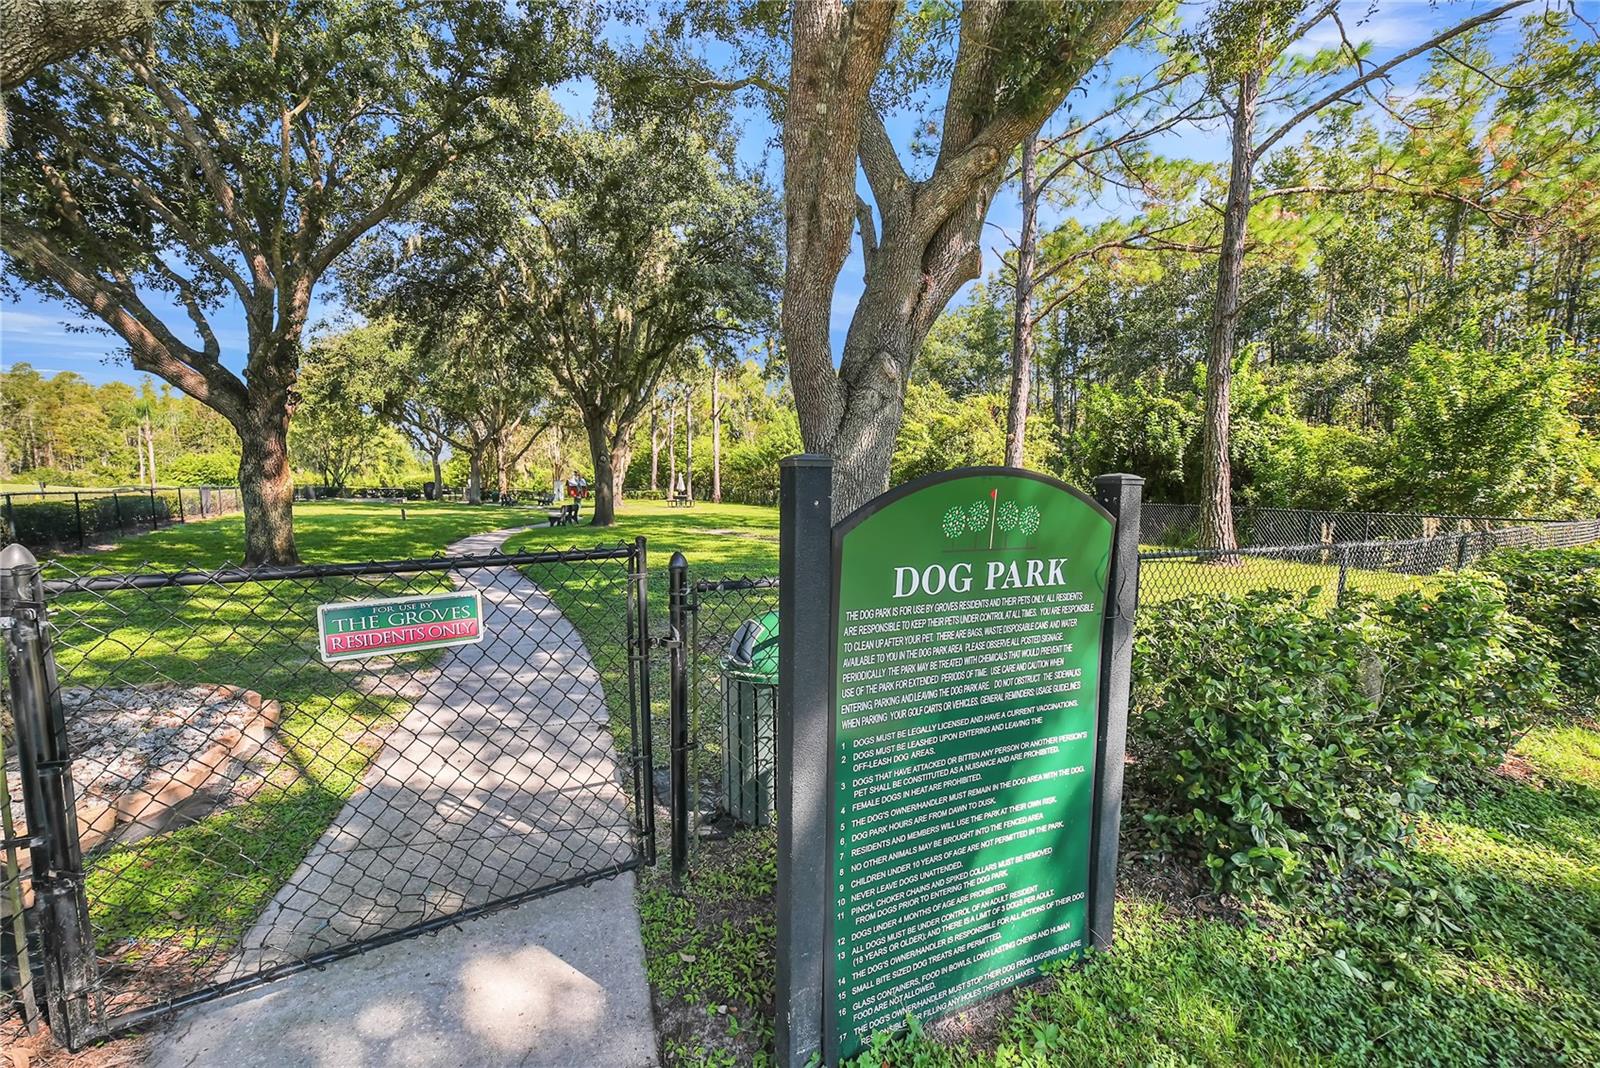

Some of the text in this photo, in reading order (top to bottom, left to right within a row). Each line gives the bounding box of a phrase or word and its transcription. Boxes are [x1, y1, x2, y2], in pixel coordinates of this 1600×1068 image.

[892, 558, 1068, 598] DOG PARK
[331, 605, 471, 632] THE GROVES
[372, 605, 395, 614] FOR
[398, 603, 417, 611] USE
[846, 610, 858, 621] THE
[860, 609, 874, 620] DOG
[875, 607, 891, 618] PARK
[892, 607, 898, 616] IS
[899, 606, 911, 615] FOR
[913, 604, 925, 614] USE
[926, 604, 934, 613] BY
[934, 601, 958, 612] GROVES
[959, 599, 989, 610] RESIDENTS
[989, 598, 1001, 607] AND
[1002, 597, 1017, 606] THEIR
[1017, 595, 1030, 605] PETS
[1046, 594, 1055, 602] ALL
[1056, 592, 1083, 601] RESIDENTS
[331, 622, 475, 650] RESIDENTS ONLY
[843, 654, 875, 668] AVAILABLE
[876, 653, 885, 663] TO
[886, 652, 898, 662] YOU
[899, 651, 905, 660] IN
[906, 649, 918, 659] THE
[918, 647, 932, 657] DOG
[933, 645, 948, 655] PARK
[965, 641, 985, 652] PLEASE
[986, 638, 1010, 649] OBSERVE
[1010, 638, 1019, 646] ALL
[1020, 635, 1041, 645] POSTED
[888, 666, 900, 676] THE
[901, 664, 916, 674] PARK
[917, 662, 929, 672] MAY
[930, 661, 937, 670] BE
[939, 657, 963, 669] TREATED
[964, 655, 978, 665] WITH
[978, 651, 1008, 663] CHEMICALS
[1009, 650, 1021, 659] THAT
[1022, 648, 1040, 657] WOULD
[1040, 645, 1062, 655] PREVENT
[1063, 643, 1072, 652] THE
[853, 736, 874, 747] DOGS
[876, 732, 896, 742] MUST
[897, 729, 906, 738] BE
[907, 724, 937, 736] LEGALLY
[937, 718, 969, 730] LICENSED
[970, 715, 983, 724] AND
[984, 712, 1000, 721] HAVE
[1007, 706, 1035, 717] CURRENT
[853, 749, 874, 761] DOGS
[876, 745, 895, 756] MUST
[896, 742, 906, 751] BE
[907, 736, 938, 749] LEASHED
[939, 732, 958, 742] UPON
[959, 726, 990, 738] ENTERING
[991, 723, 1004, 732] AND
[1005, 719, 1030, 730] LEAVING
[853, 756, 892, 772] OFF-LEASH
[893, 753, 908, 763] DOG
[852, 831, 868, 842] DOG
[869, 825, 888, 837] PARK
[889, 818, 913, 831] HOURS
[914, 814, 927, 824] ARE
[928, 809, 947, 820] FROM
[948, 804, 967, 815] DAWN
[851, 871, 886, 888] CHILDREN
[887, 863, 911, 876] UNDER
[912, 860, 920, 868] 10
[921, 854, 942, 865] YEARS
[943, 850, 953, 859] OF
[953, 846, 966, 856] AGE
[967, 843, 980, 852] ARE
[980, 839, 994, 848] NOT
[995, 830, 1028, 844] PERMITTED
[1028, 828, 1035, 836] IN
[1036, 825, 1047, 833] THE
[837, 912, 844, 920] 11
[876, 892, 905, 907] CHOKER
[906, 883, 930, 897] CHAINS
[931, 879, 945, 889] AND
[946, 871, 968, 884] SPIKED
[969, 863, 997, 877] COLLARS
[998, 858, 1014, 868] MUST
[1015, 855, 1023, 863] BE
[1023, 847, 1052, 860] REMOVED
[837, 898, 845, 906] 10
[851, 888, 875, 902] NEVER
[876, 881, 898, 894] LEAVE
[899, 874, 918, 886] DOGS
[855, 912, 876, 925] FROM
[877, 905, 897, 918] DOGS
[898, 897, 919, 910] PRIOR
[920, 894, 929, 902] TO
[930, 883, 962, 900] ENTERING
[963, 879, 976, 888] THE
[976, 875, 990, 885] DOG
[838, 937, 845, 945] 12
[851, 927, 872, 941] DOGS
[873, 919, 897, 933] UNDER
[904, 906, 931, 922] MONTHS
[932, 903, 942, 912] OF
[942, 898, 955, 909] AGE
[956, 894, 969, 904] ARE
[838, 991, 846, 1000] 15
[852, 981, 874, 995] SMALL
[876, 973, 891, 985] BITE
[892, 965, 912, 979] SIZED
[912, 959, 927, 971] DOG
[928, 949, 952, 964] TREATS
[953, 944, 966, 955] ARE
[839, 1008, 846, 1016] 16
[852, 995, 876, 1011] GLASS
[922, 969, 940, 982] FOOD
[941, 966, 947, 974] IN
[973, 950, 990, 962] LONG
[991, 941, 1015, 955] LASTING
[1015, 933, 1037, 946] CHEWS
[1037, 929, 1049, 938] AND
[1050, 922, 1070, 934] HUMAN
[853, 1007, 873, 1022] FOOD
[874, 1001, 888, 1013] ARE
[889, 994, 903, 1006] NOT
